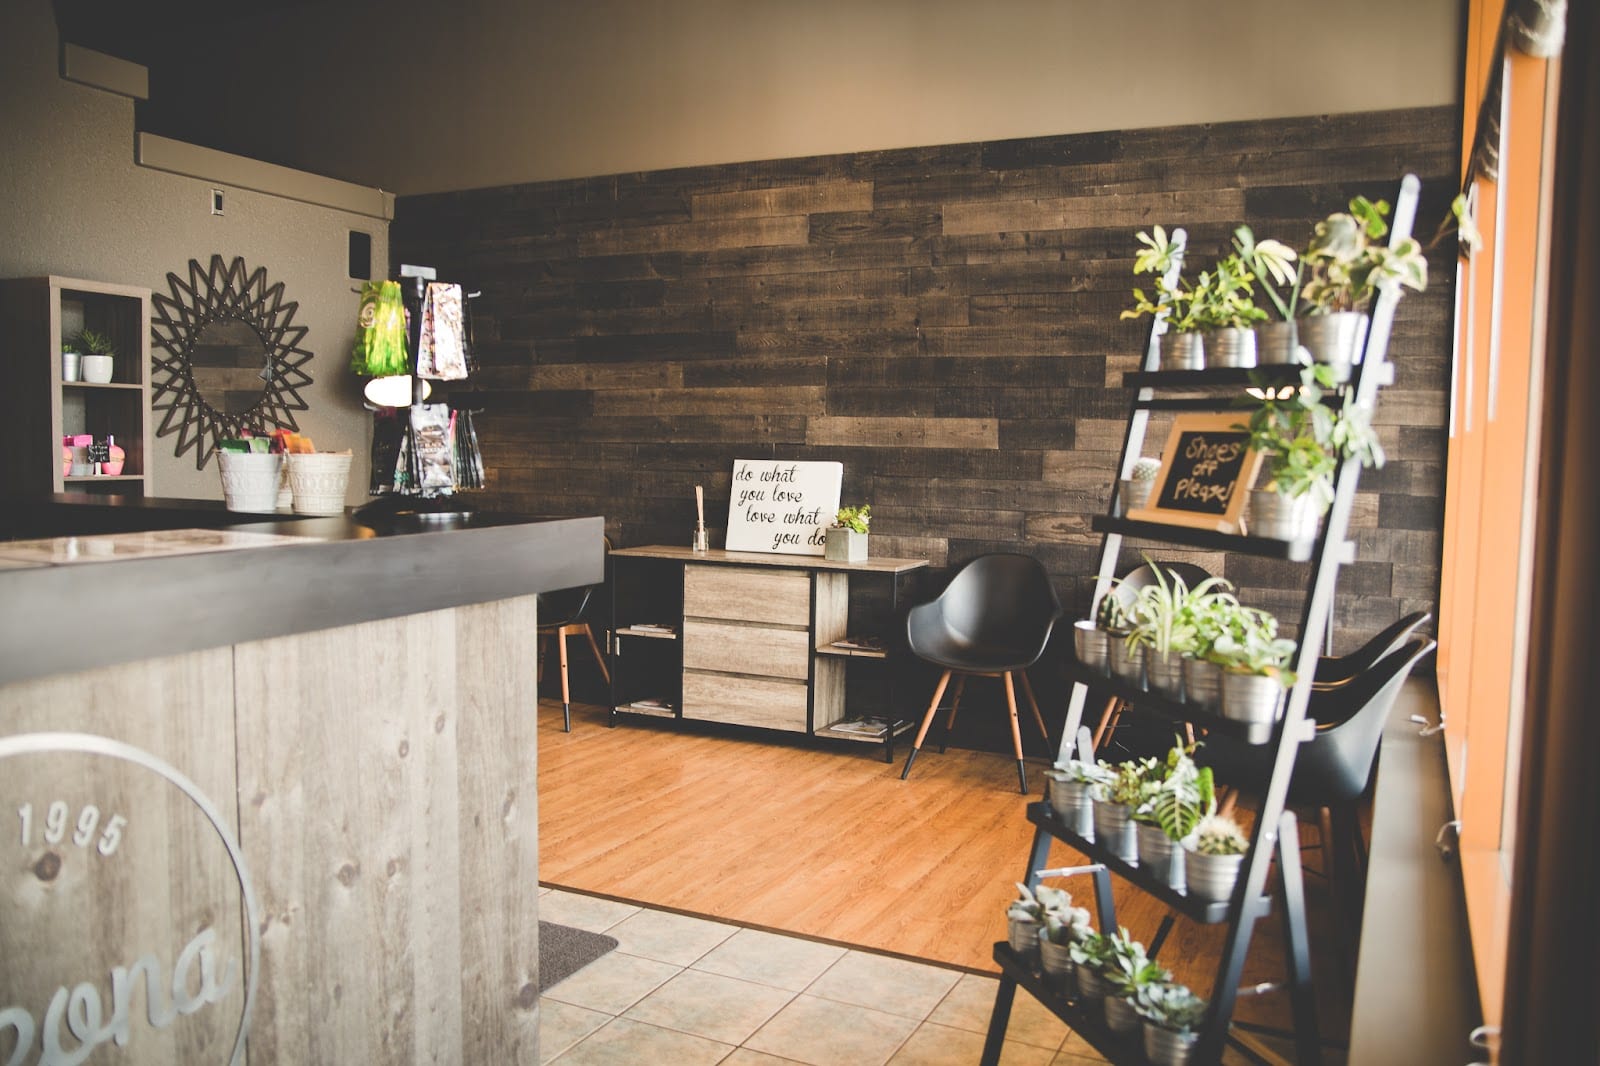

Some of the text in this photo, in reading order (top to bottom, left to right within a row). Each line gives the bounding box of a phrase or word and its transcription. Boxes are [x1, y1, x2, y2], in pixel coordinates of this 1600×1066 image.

[1186, 436, 1240, 462] Shoes
[735, 463, 800, 483] do what
[1192, 460, 1218, 476] off
[738, 484, 804, 506] you love
[746, 504, 823, 526] love what
[772, 528, 826, 550] you do
[18, 800, 127, 856] 1995
